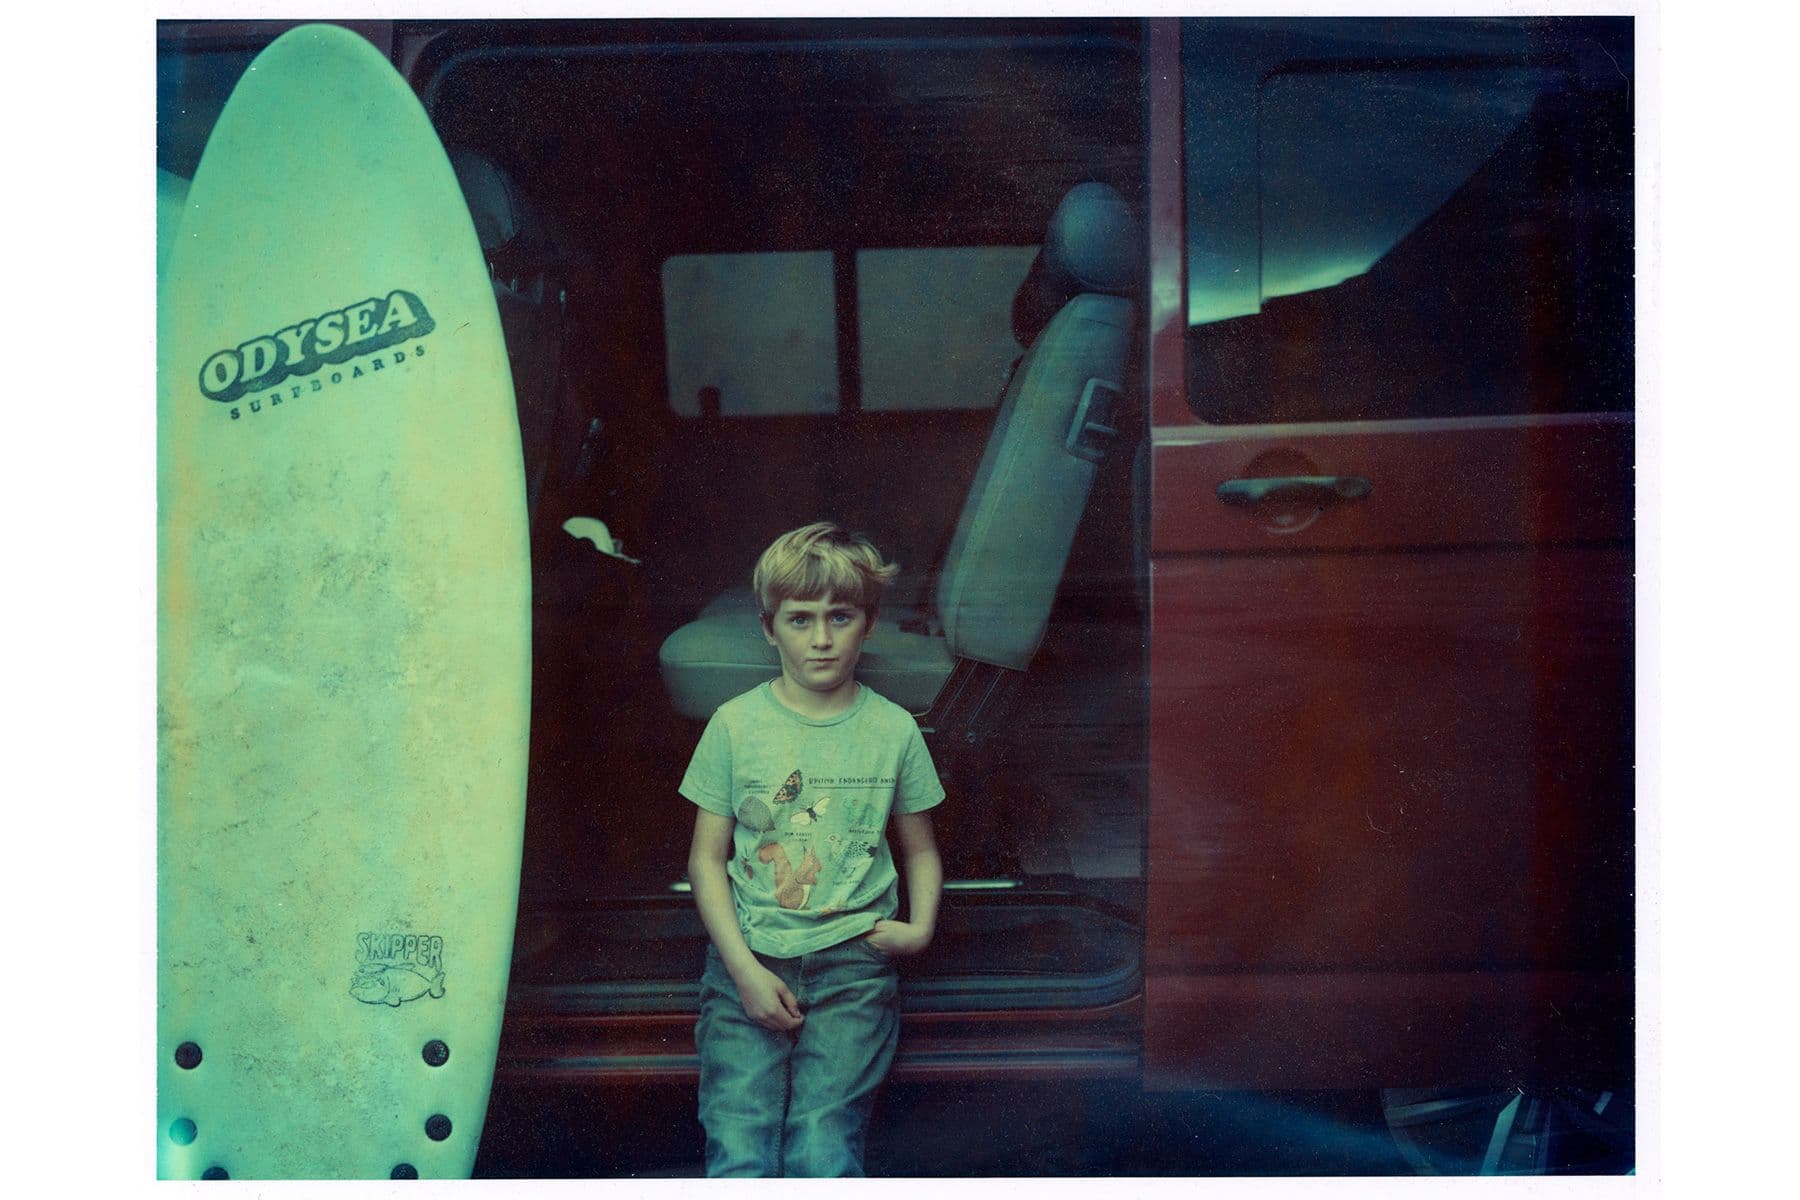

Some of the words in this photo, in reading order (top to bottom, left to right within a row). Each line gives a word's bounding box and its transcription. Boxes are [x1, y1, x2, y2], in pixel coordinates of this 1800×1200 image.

[199, 289, 436, 402] ODYSEA
[230, 345, 425, 420] SURFBOARDS
[355, 931, 443, 973] SKIPPER
